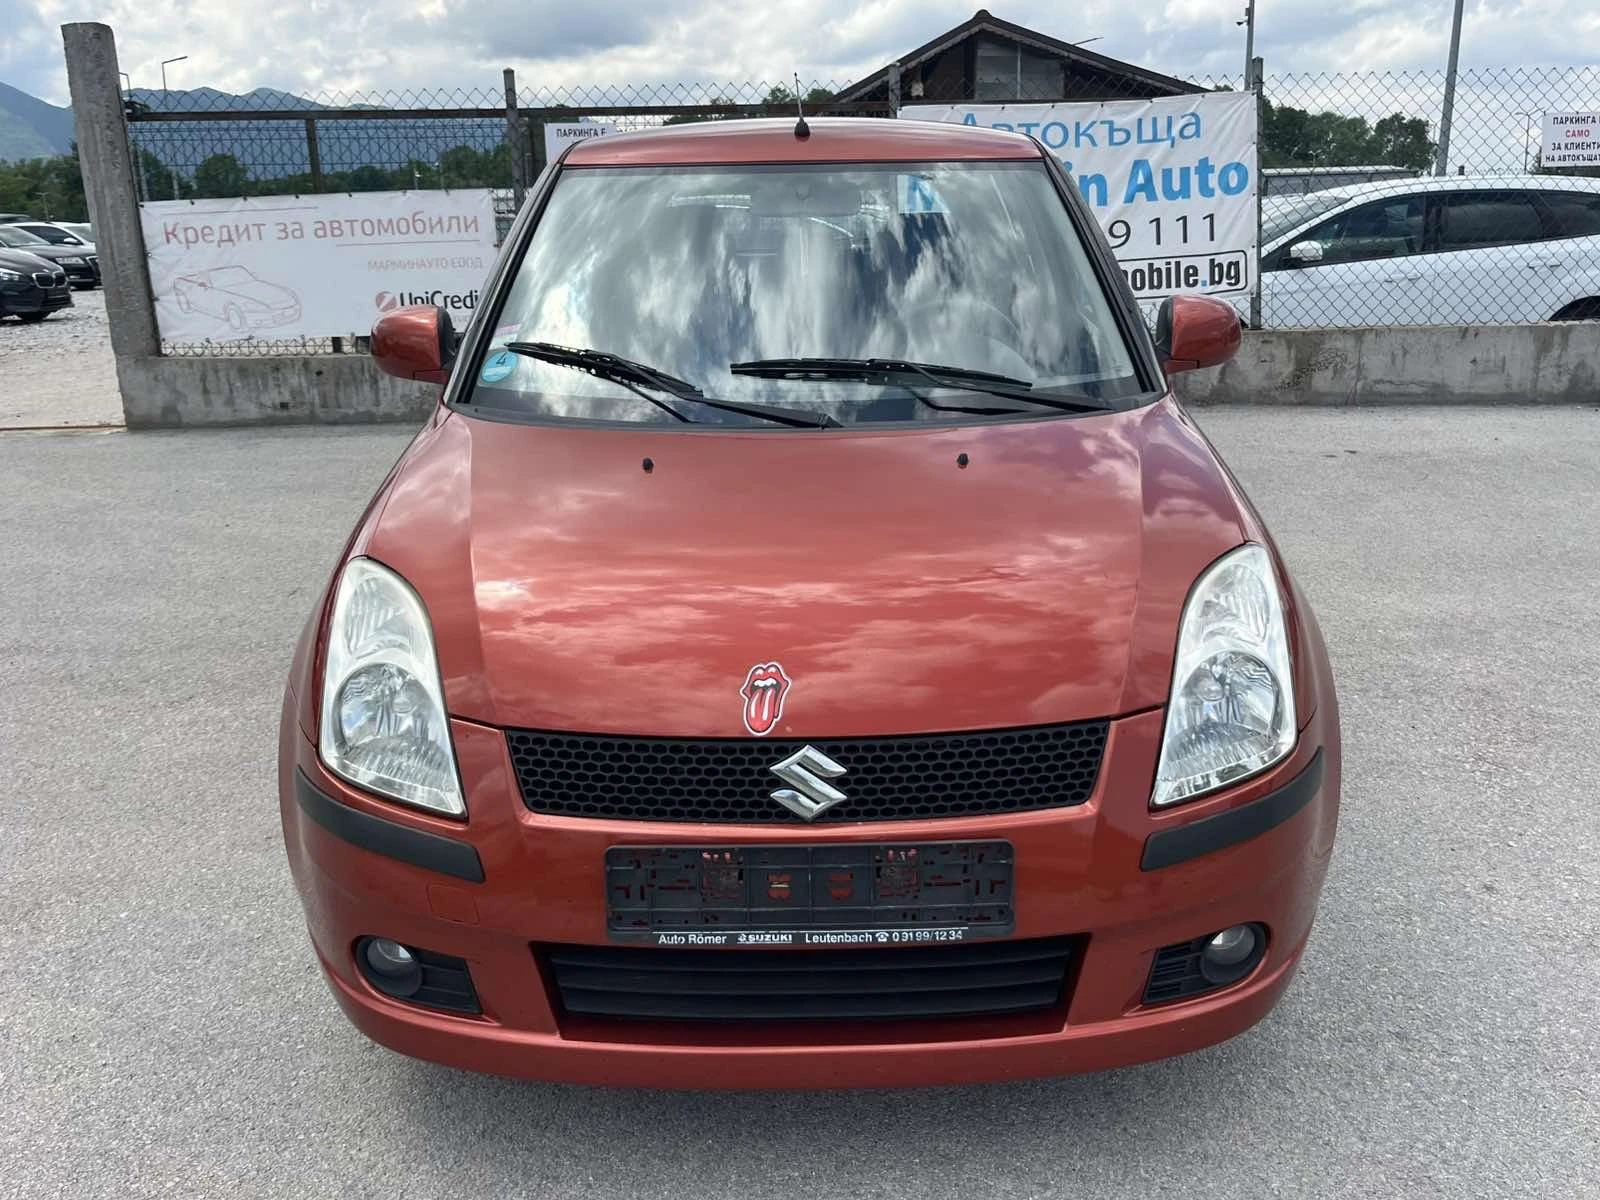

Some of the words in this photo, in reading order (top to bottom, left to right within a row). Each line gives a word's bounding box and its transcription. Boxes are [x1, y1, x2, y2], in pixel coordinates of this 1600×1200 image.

[1553, 116, 1597, 125] ПАРКИНГА
[556, 128, 599, 138] ПАРКИНГА
[1565, 129, 1590, 138] САМО
[1551, 142, 1562, 151] ЗА
[1545, 154, 1556, 162] НА
[1123, 156, 1249, 205] Auto
[162, 220, 267, 250] Кредит
[275, 221, 305, 241] за
[313, 210, 480, 240] автомобили
[658, 933, 686, 944] Auto
[688, 933, 727, 944] Römer
[748, 933, 793, 943] SUZUKI
[805, 932, 873, 943] Leutenbach
